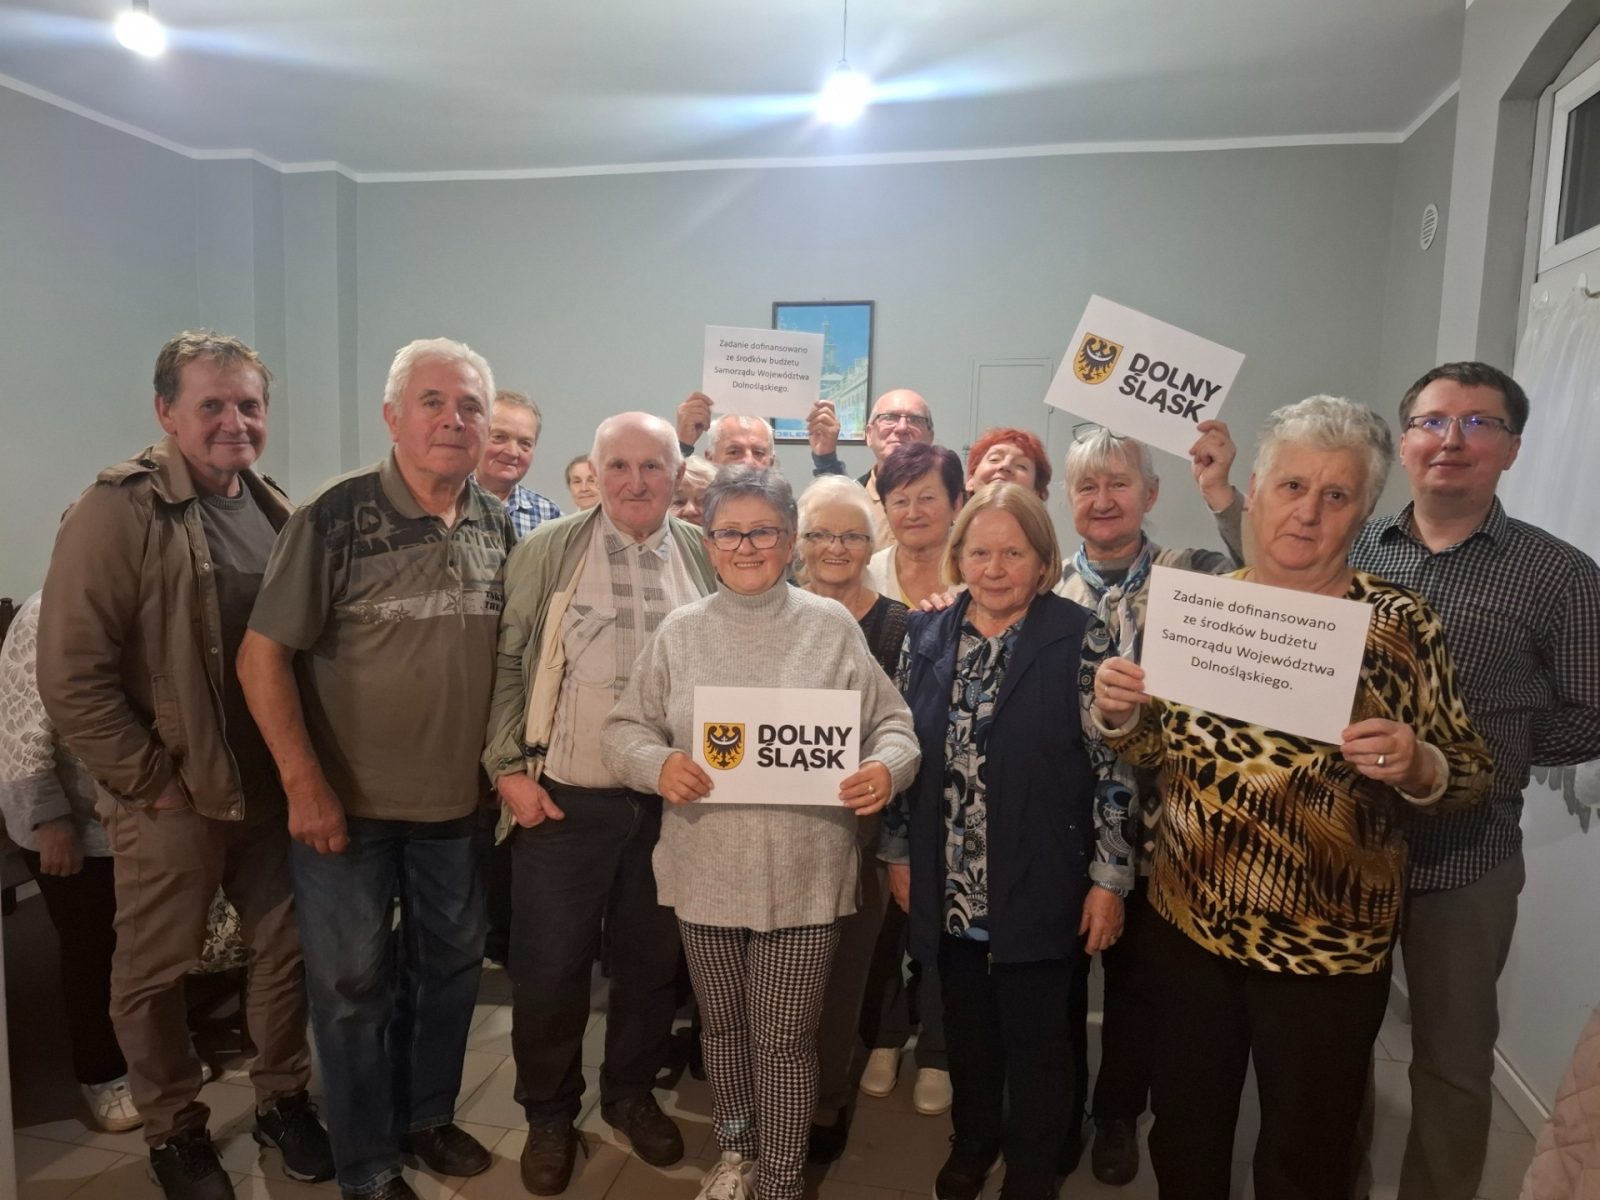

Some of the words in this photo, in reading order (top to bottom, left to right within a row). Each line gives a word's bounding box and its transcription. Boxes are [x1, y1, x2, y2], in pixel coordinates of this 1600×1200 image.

[719, 339, 749, 349] Zadanie
[750, 342, 808, 354] dofinansowano
[736, 354, 767, 364] środków
[714, 365, 755, 377] Samorządu
[757, 369, 810, 381] Województwa
[732, 380, 789, 394] Dolnośląskiego.
[1128, 352, 1222, 402] DOLNY
[1118, 373, 1206, 423] ŚLĄSK
[1173, 590, 1225, 609] Zadanie
[1227, 600, 1337, 632] dofinansowano
[1183, 614, 1197, 625] ze
[1200, 613, 1256, 638] środków
[1259, 629, 1318, 651] budżetu
[1161, 628, 1233, 655] Samorządu
[1236, 645, 1335, 677] Województwa
[1191, 656, 1293, 690] Dolnośląskiego.
[758, 724, 853, 747] DOLNY
[757, 741, 845, 772] ŚLĄSK
